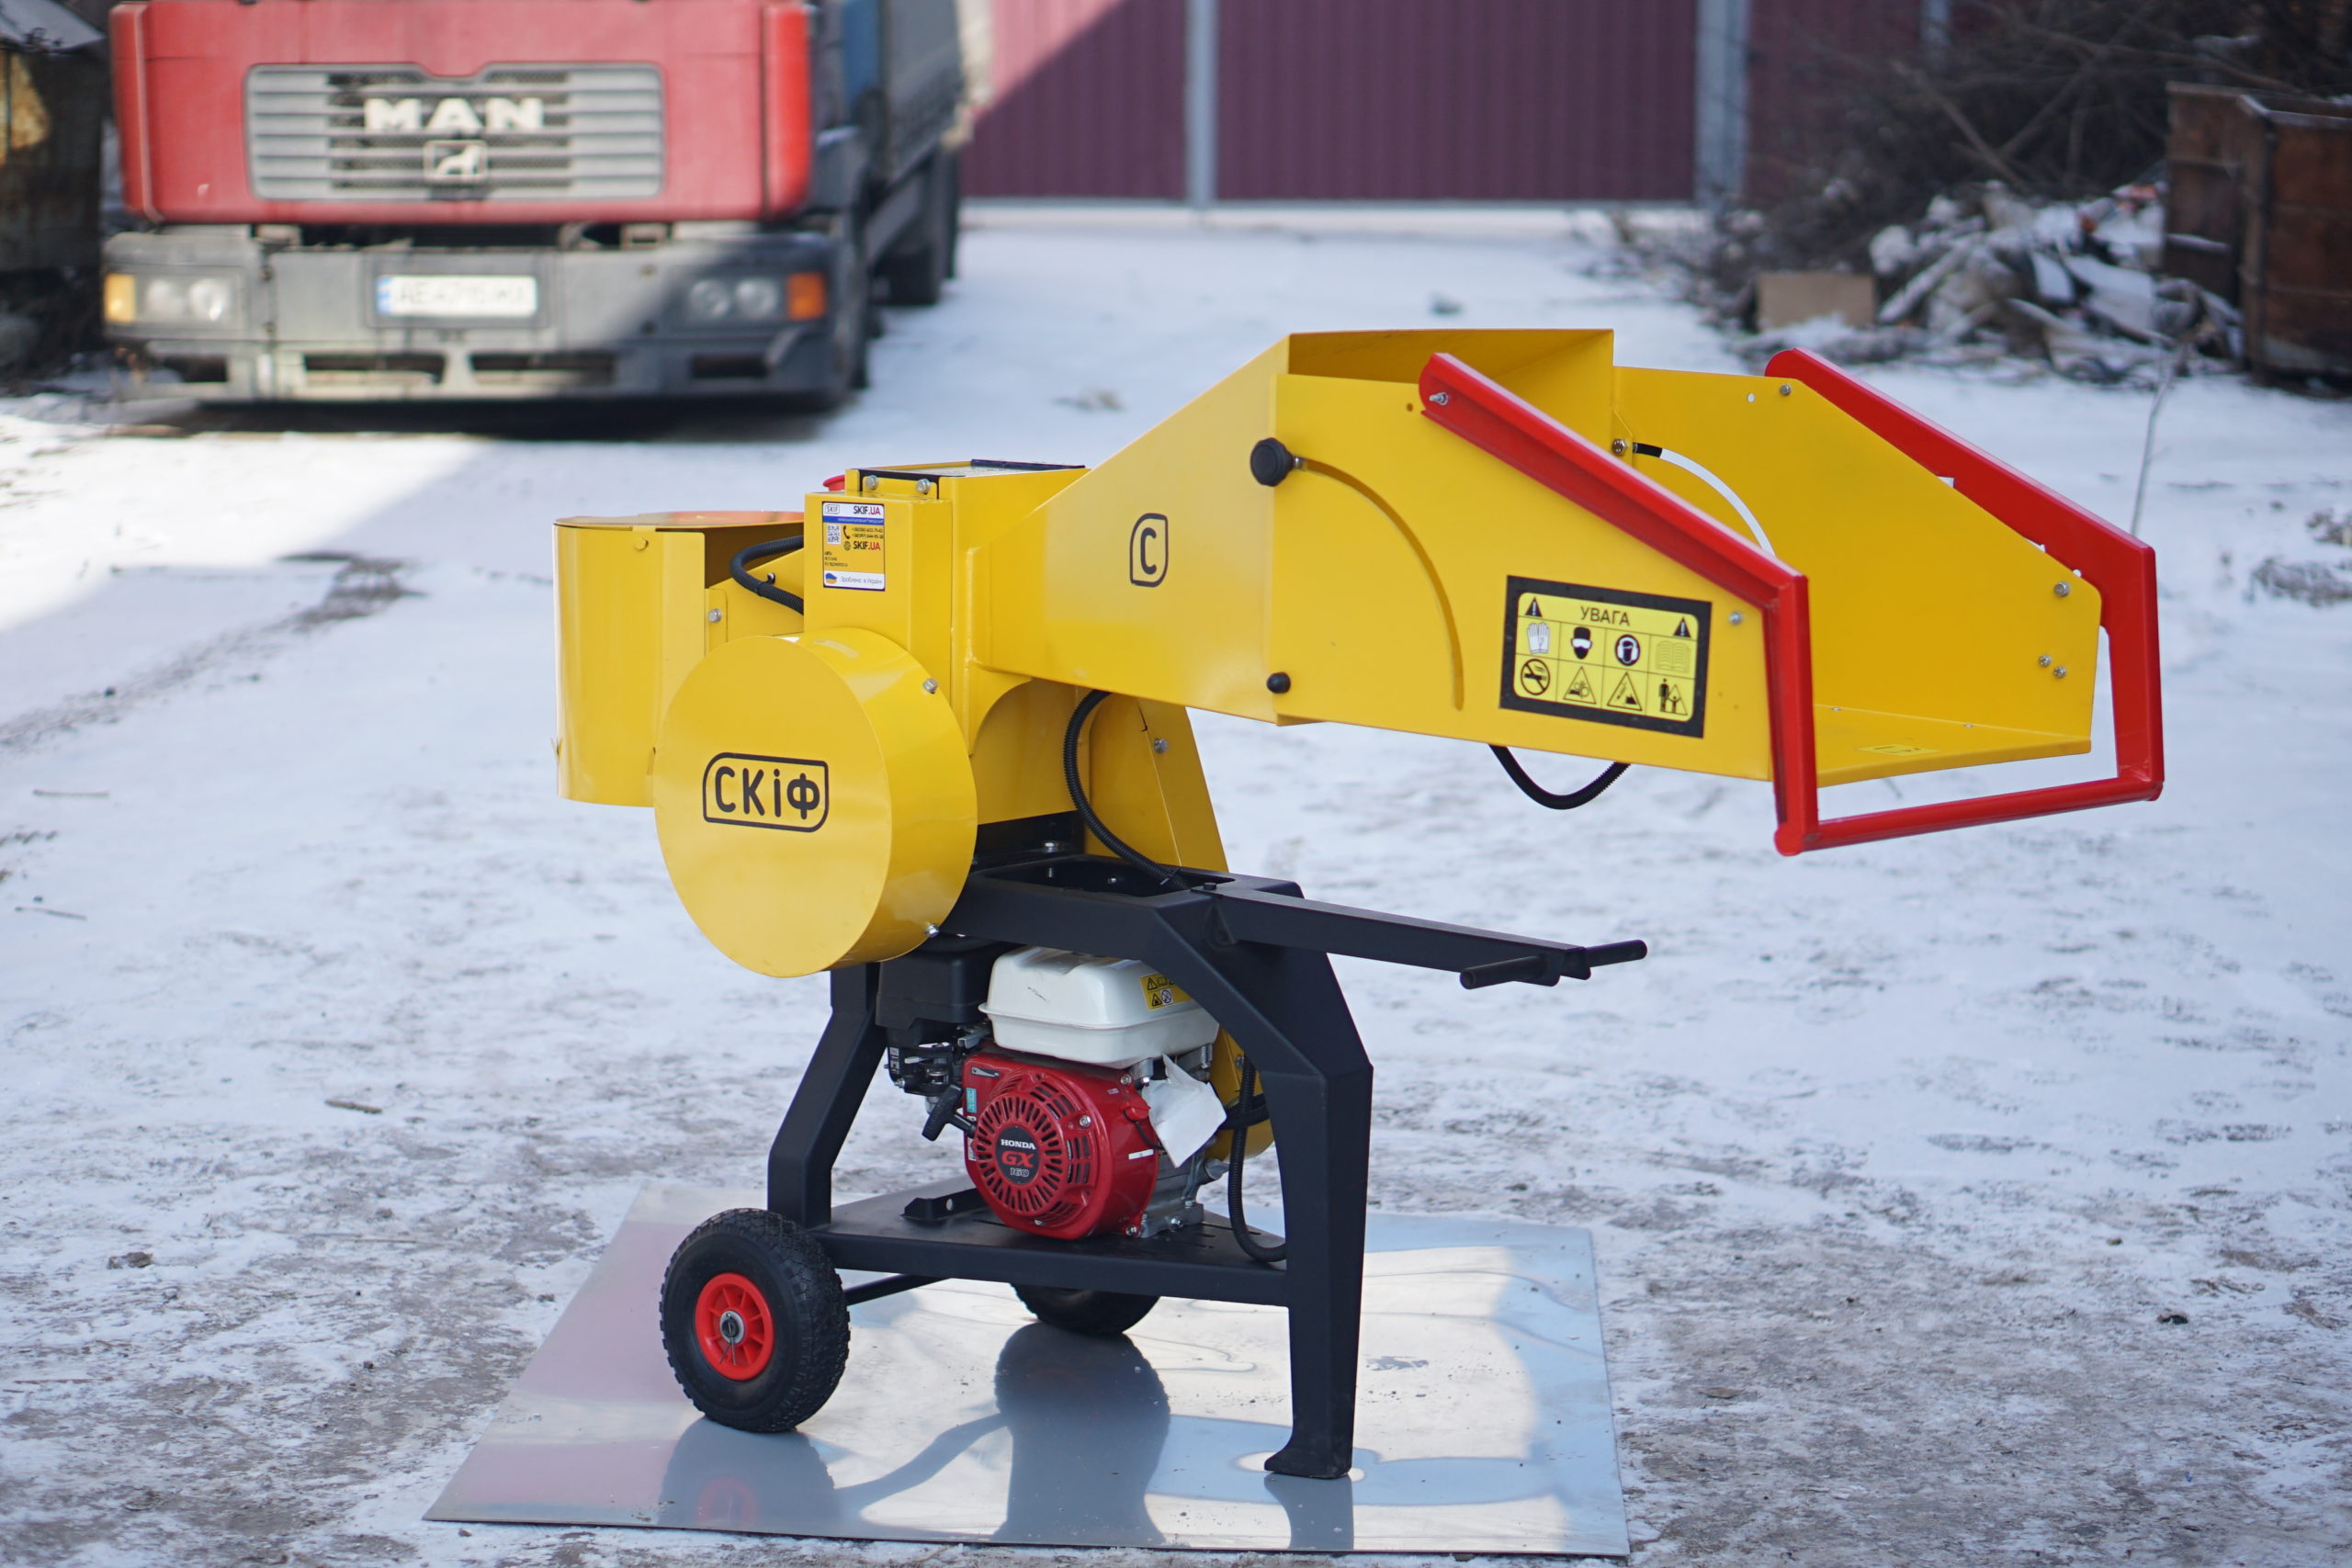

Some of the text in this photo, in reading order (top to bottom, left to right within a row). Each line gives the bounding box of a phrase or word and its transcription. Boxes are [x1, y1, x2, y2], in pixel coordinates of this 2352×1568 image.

[364, 97, 544, 134] MAN
[854, 505, 881, 515] SKIF.UA
[853, 540, 881, 551] SKIF.UA
[1580, 605, 1631, 626] УВАГА
[1001, 1139, 1036, 1150] HONDA
[1001, 1150, 1034, 1168] GX
[1010, 1168, 1030, 1178] 160
